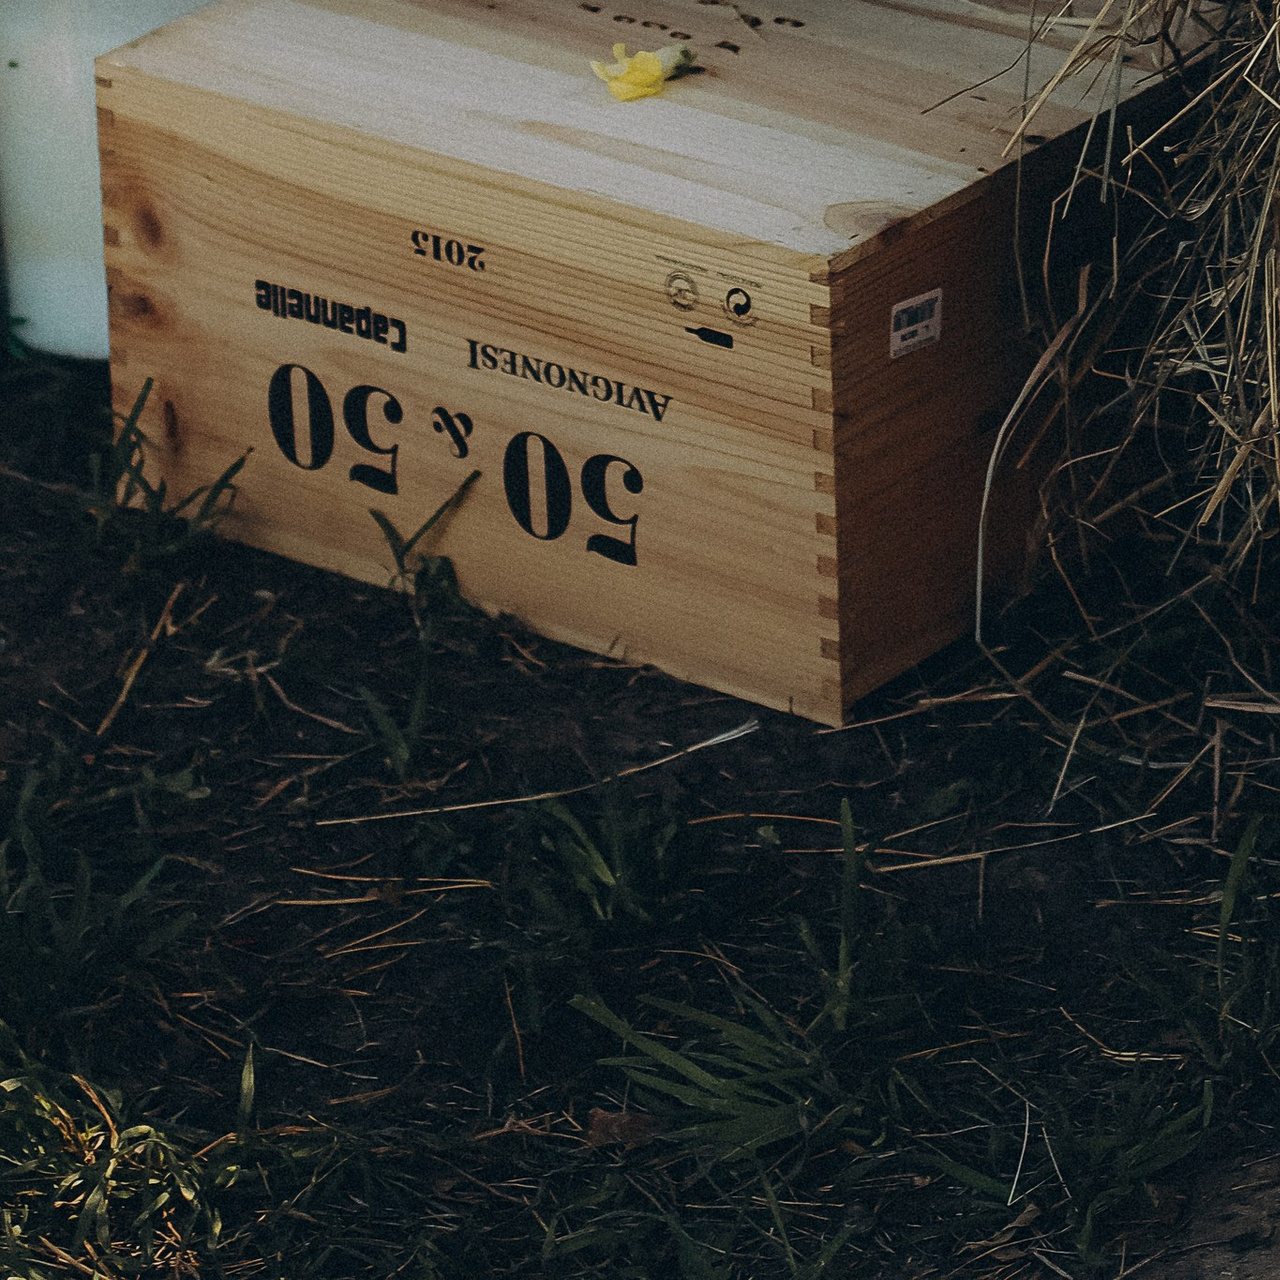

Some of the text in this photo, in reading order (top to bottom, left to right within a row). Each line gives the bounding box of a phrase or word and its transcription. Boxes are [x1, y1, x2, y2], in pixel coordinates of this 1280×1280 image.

[410, 230, 485, 272] 2015
[255, 279, 407, 353] Capannelle
[466, 338, 674, 423] AVIGNONESI
[268, 363, 644, 566] 50 & 50
